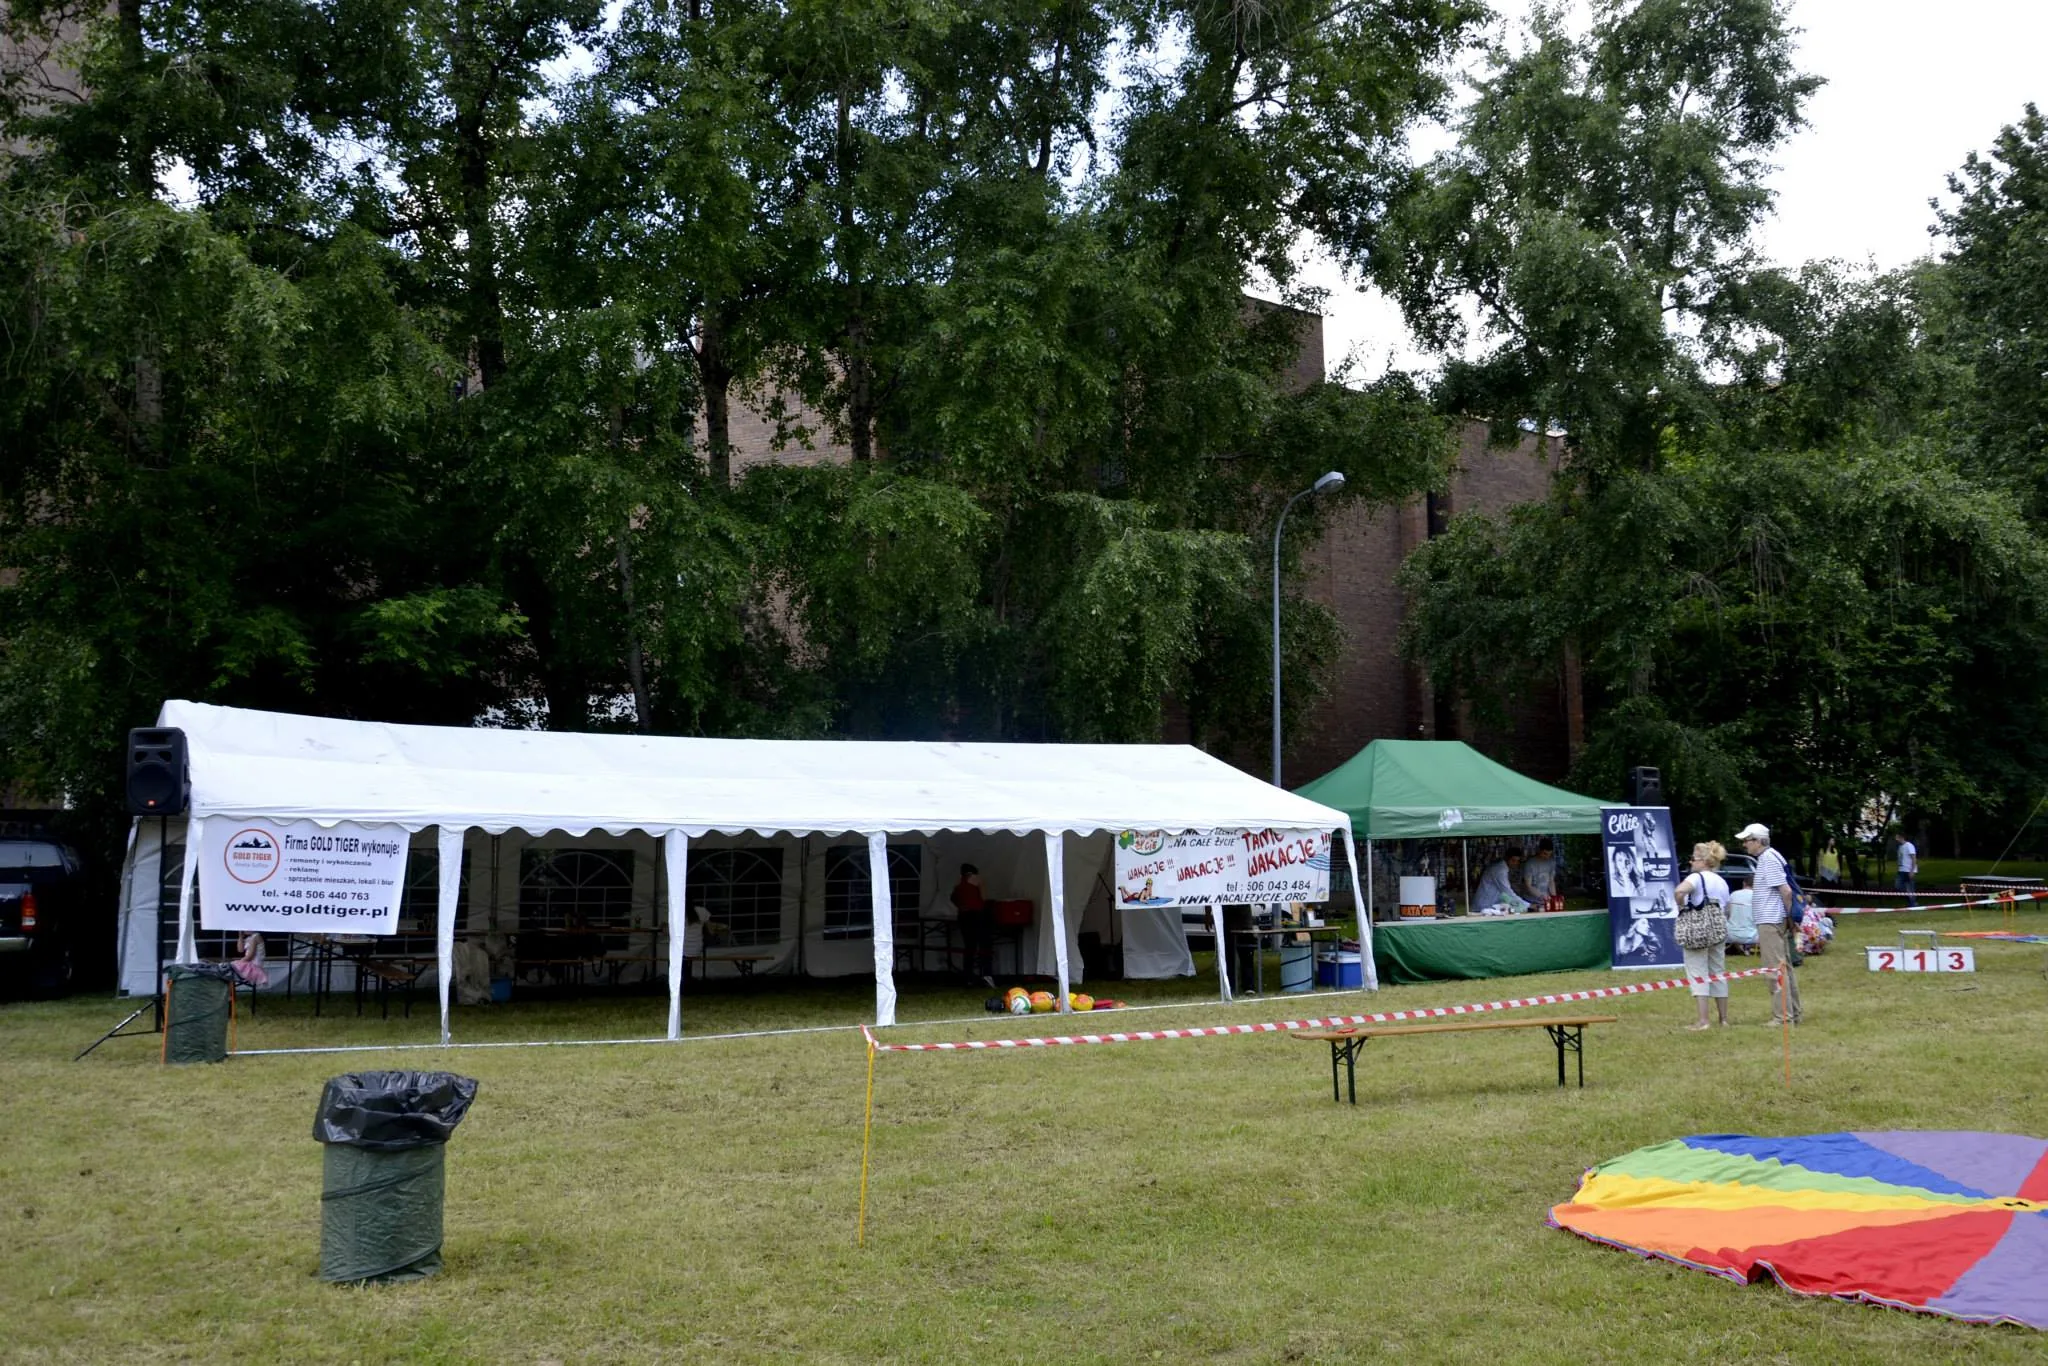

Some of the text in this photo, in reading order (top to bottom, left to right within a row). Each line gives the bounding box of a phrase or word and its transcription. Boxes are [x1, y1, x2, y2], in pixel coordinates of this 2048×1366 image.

[1608, 813, 1640, 835] Ellie
[285, 834, 400, 858] Firma GOLD TIGER wykonuje:
[232, 851, 272, 861] GOLD TIGER
[289, 857, 320, 865] remonty
[1247, 838, 1316, 877] WAKACJE
[289, 866, 319, 875] reklamę
[1127, 861, 1165, 881] WAKACJE
[1176, 858, 1224, 882] WAKACJE
[288, 875, 323, 884] sprzątanie
[358, 877, 375, 885] lokali
[381, 878, 394, 886] biur
[1247, 881, 1264, 892] 506
[1268, 881, 1287, 891] 043
[1290, 880, 1311, 891] 484
[262, 889, 370, 901] tel. +48 506 440 763
[225, 903, 388, 919] www.goldtiger.pl
[1878, 951, 1964, 971] 2 1 3
